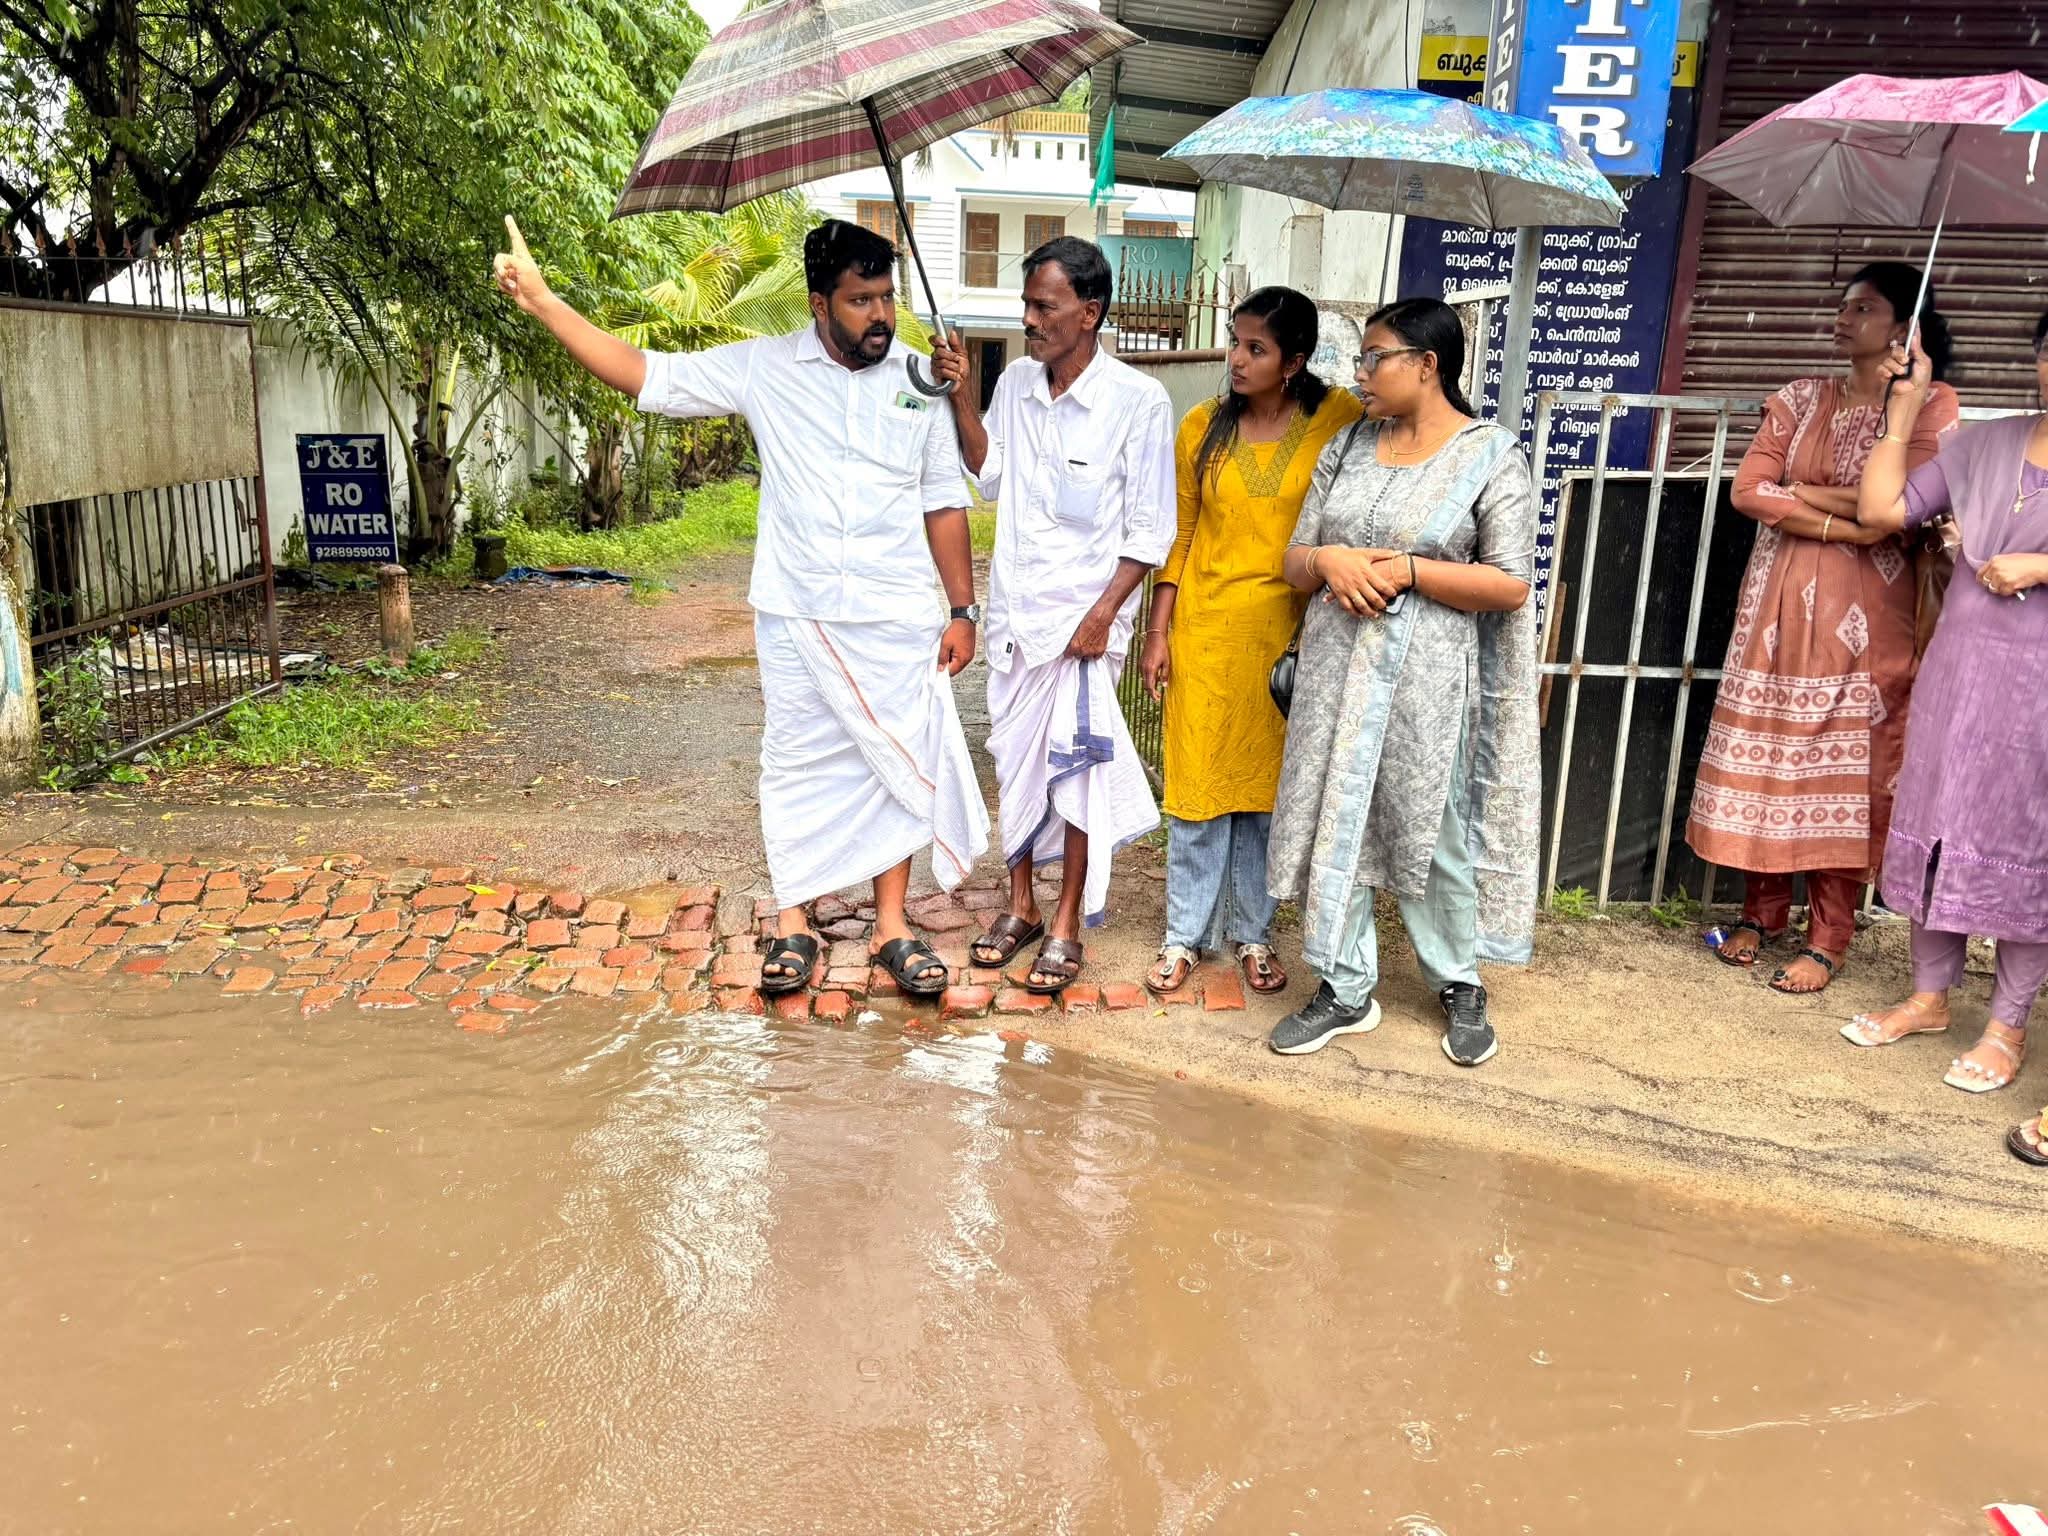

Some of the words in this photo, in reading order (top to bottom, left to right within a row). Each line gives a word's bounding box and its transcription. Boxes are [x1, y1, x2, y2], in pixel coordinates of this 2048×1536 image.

[1597, 232, 1642, 253] ഗ്രാഫ്
[1126, 244, 1158, 264] RO
[1582, 256, 1632, 276] ബുക്ക്
[1565, 280, 1629, 300] കോളേജ്
[1546, 325, 1621, 343] പെൻസിൽ
[1578, 373, 1614, 393] കളർ
[325, 482, 363, 507] RO
[308, 513, 389, 535] WATER
[315, 546, 391, 558] 9288959030
